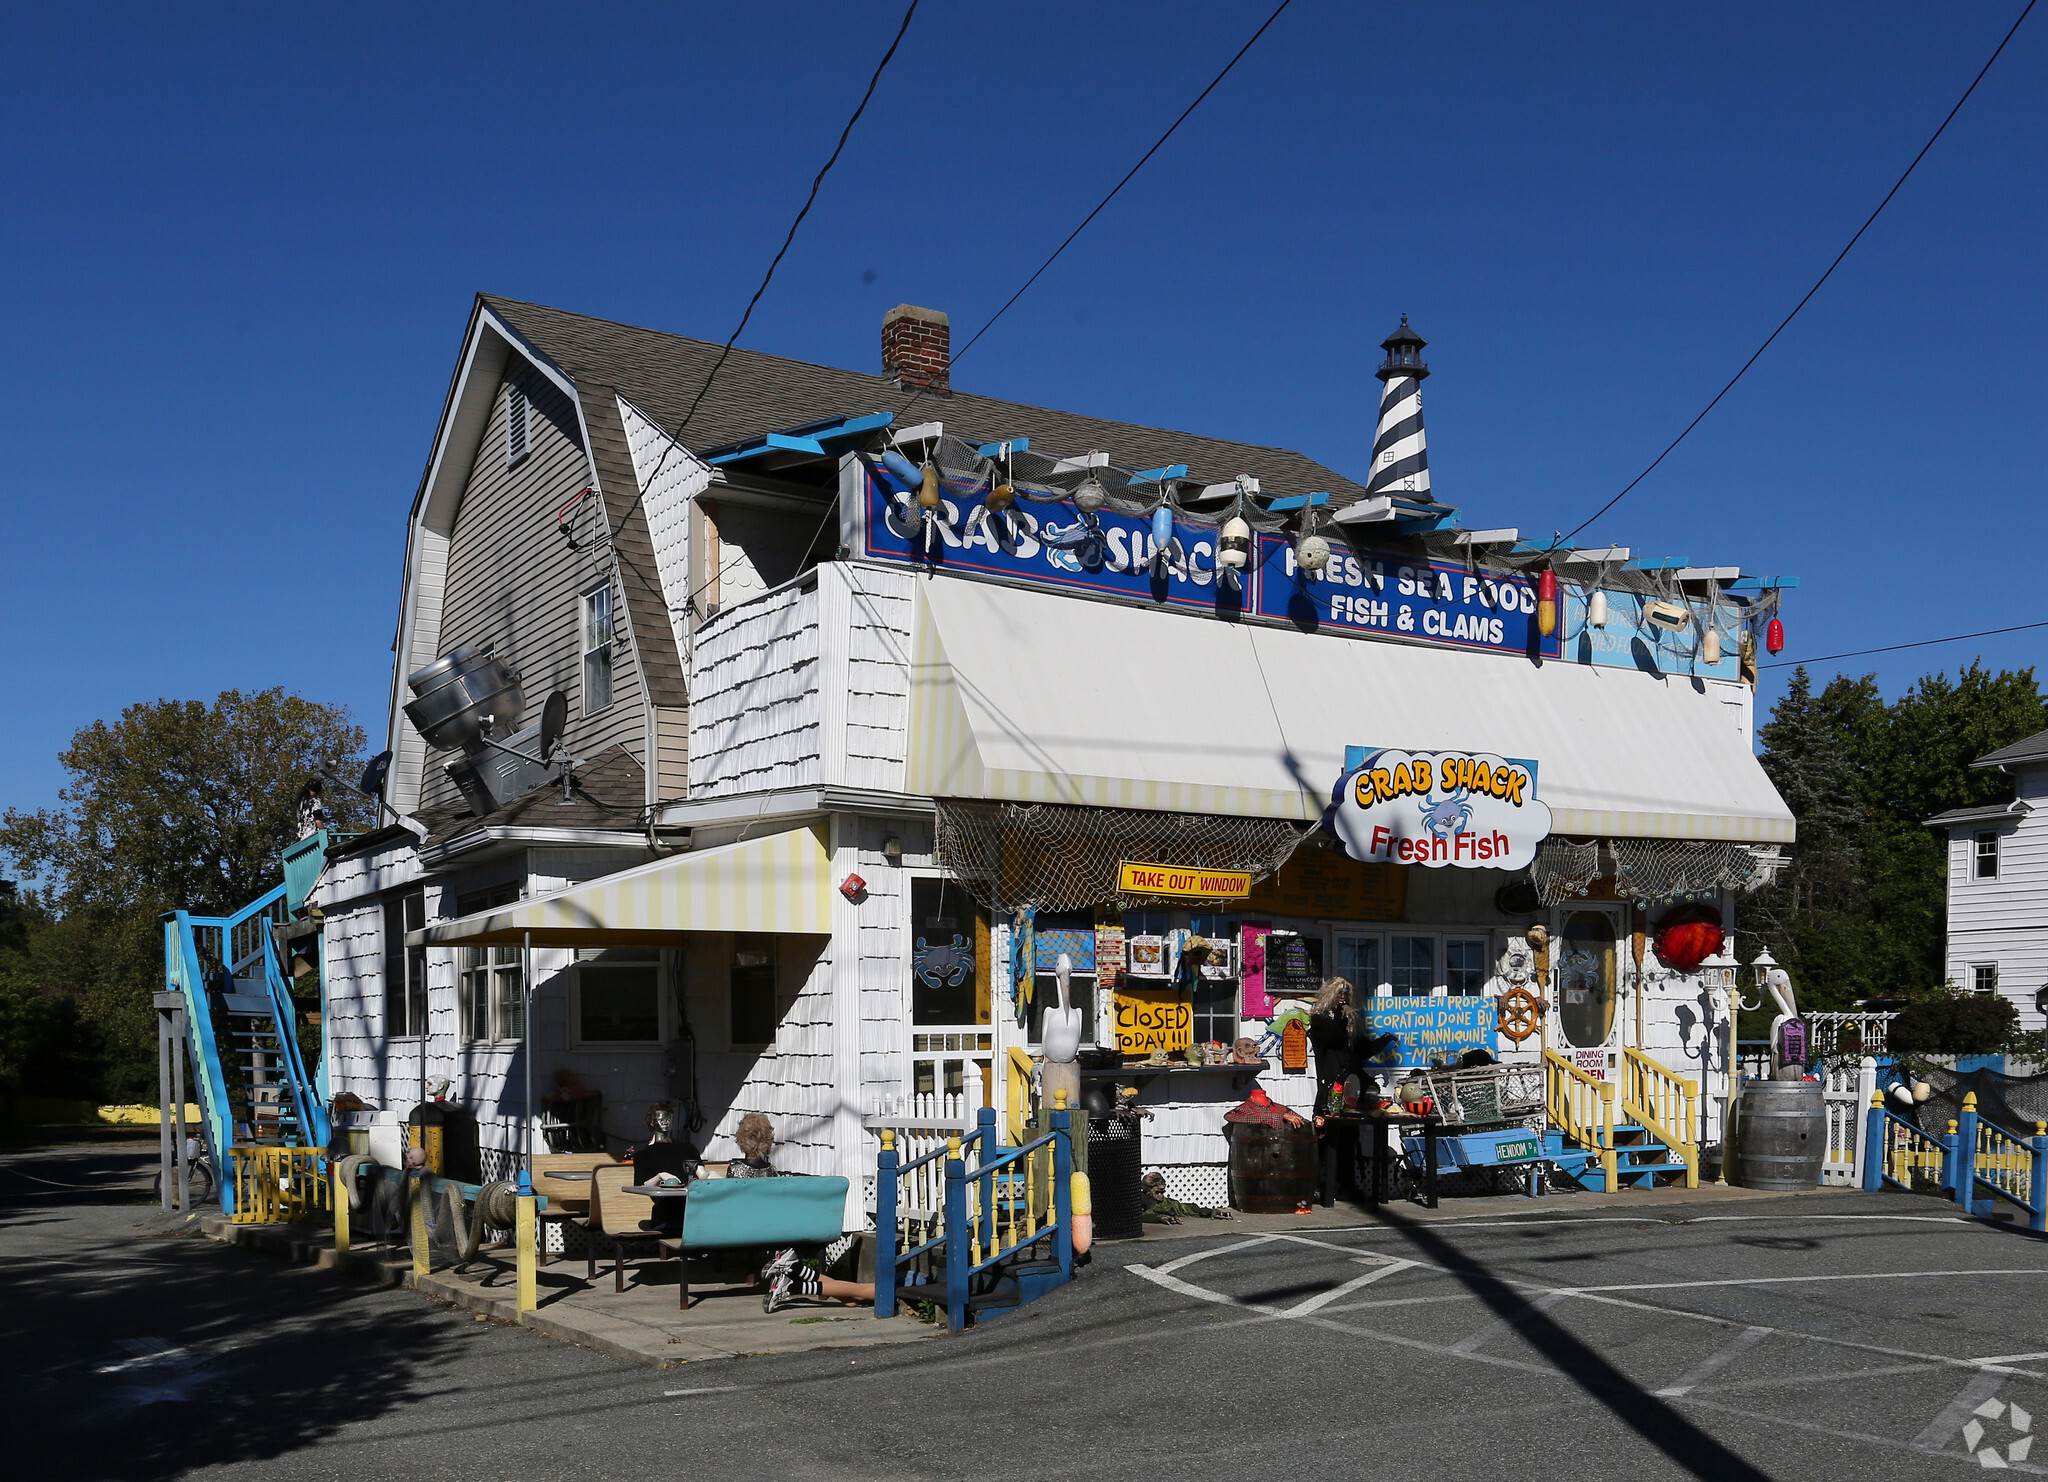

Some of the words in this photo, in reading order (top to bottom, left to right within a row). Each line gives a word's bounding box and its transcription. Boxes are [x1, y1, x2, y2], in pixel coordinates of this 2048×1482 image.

[884, 490, 1041, 559] CRAB
[1398, 566, 1453, 602] SEA
[1463, 576, 1537, 614] FOOD
[1331, 594, 1388, 626] FISH
[1396, 604, 1415, 631] &
[1422, 609, 1504, 644] CLAMS
[1355, 759, 1433, 809] CRAB
[1441, 758, 1527, 808] SHACK
[1370, 825, 1448, 861] Fresh
[1454, 830, 1509, 860] Fish
[1131, 871, 1165, 888] TAKE
[1168, 875, 1196, 890] OUT
[1200, 877, 1246, 892] WINDOW
[1364, 1011, 1434, 1030] ECORATION
[1437, 1011, 1472, 1028] DONE
[1575, 1050, 1604, 1059] DINING
[1576, 1059, 1603, 1068] ROOM
